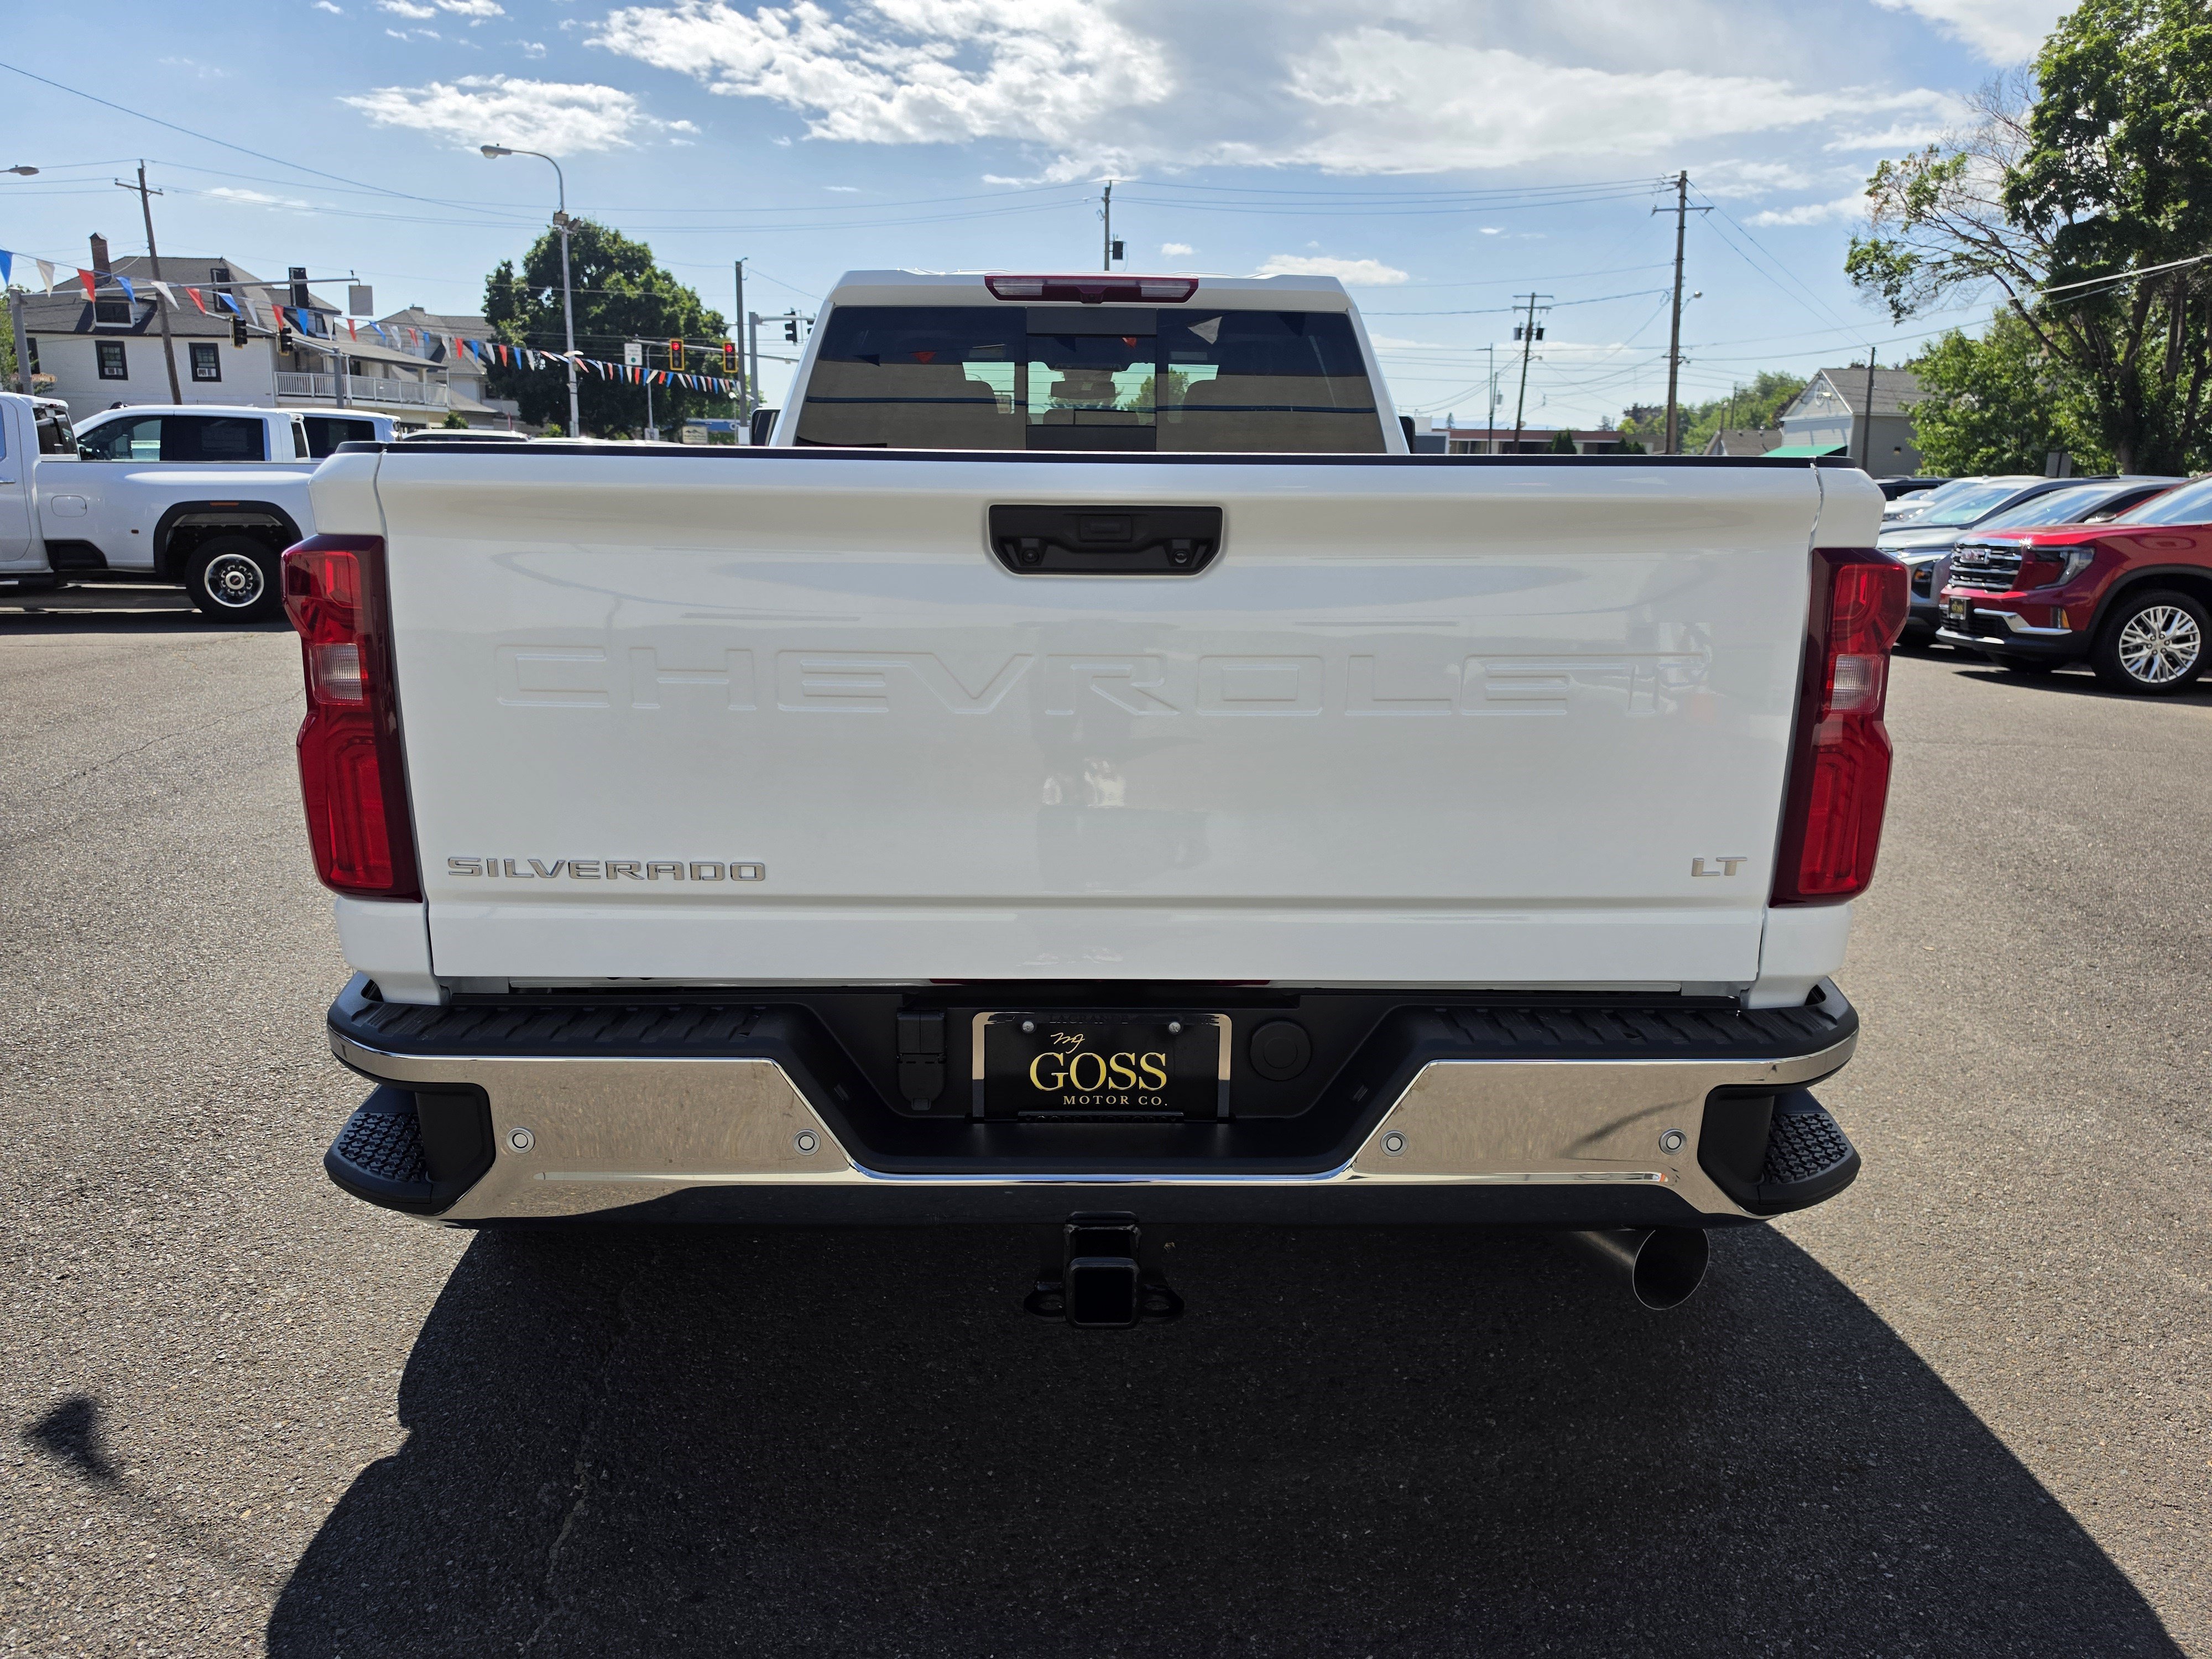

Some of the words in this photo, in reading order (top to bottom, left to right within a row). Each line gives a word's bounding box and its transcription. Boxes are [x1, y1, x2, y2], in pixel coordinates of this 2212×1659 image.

[495, 644, 1708, 716] CHEVROLET
[447, 856, 766, 882] SILVERADO
[1691, 857, 1747, 877] LT
[1030, 1052, 1167, 1092] GOSS
[1063, 1095, 1129, 1105] MOTOR
[1138, 1095, 1167, 1106] CO.
